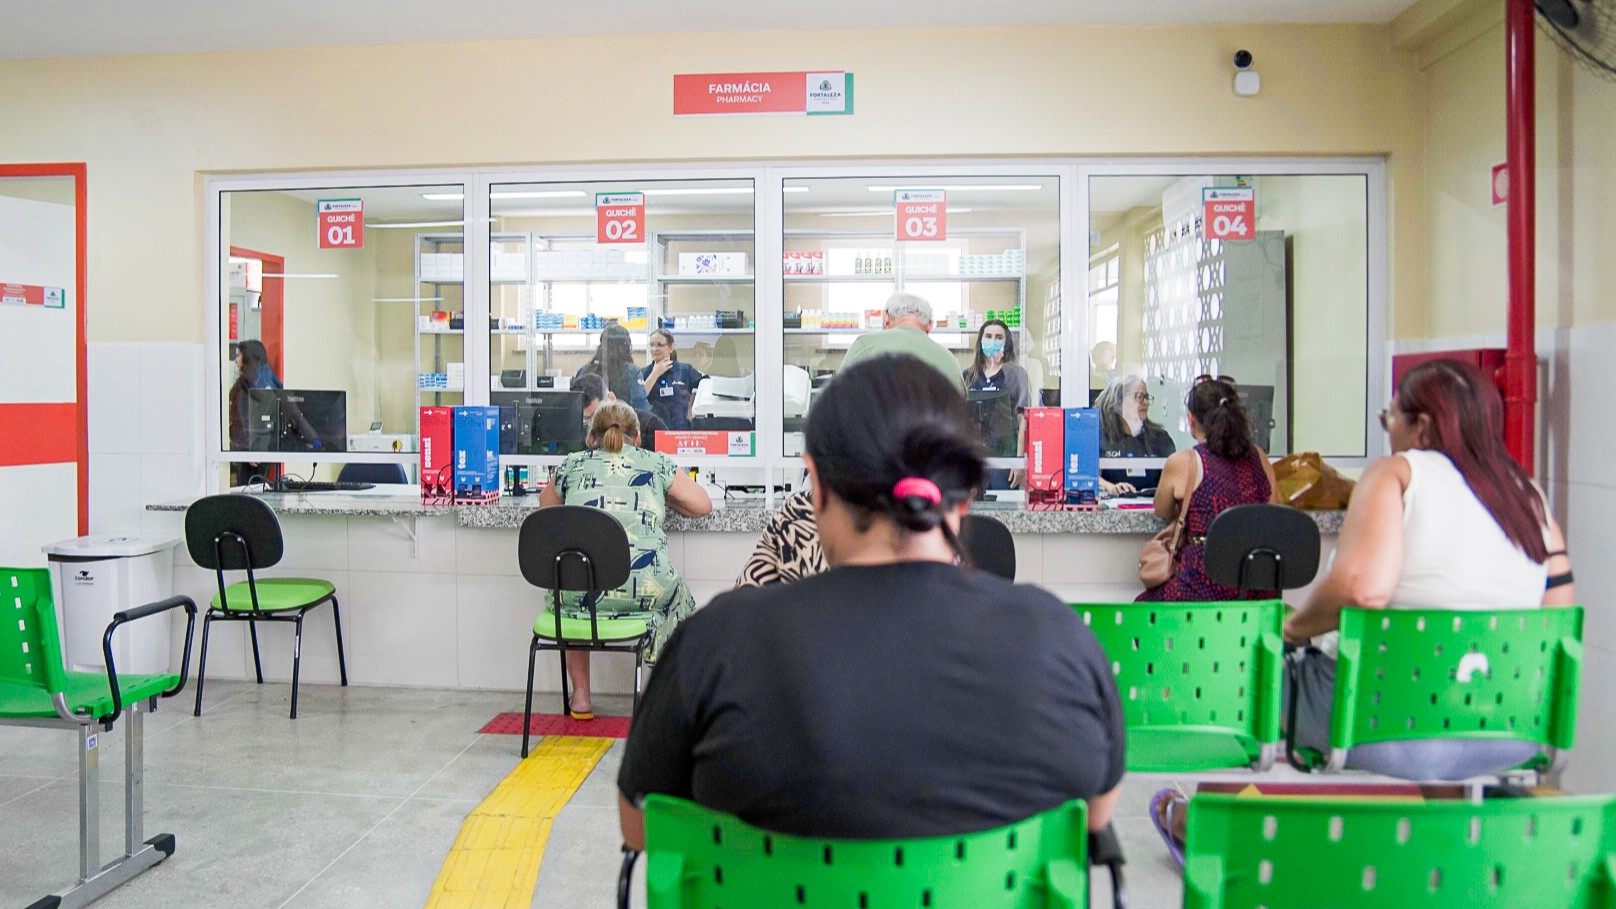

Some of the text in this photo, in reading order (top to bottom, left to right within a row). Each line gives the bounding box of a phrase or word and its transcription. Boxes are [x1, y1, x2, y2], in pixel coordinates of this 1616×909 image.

[708, 80, 772, 94] FARMÁCIA
[716, 95, 763, 104] PHARMACY
[605, 207, 637, 217] GUICHÊ
[905, 203, 938, 214] GUICHÊ
[1213, 202, 1246, 212] GUICHÊ
[327, 213, 356, 223] GUICHÊ
[1213, 215, 1247, 236] 04
[327, 225, 356, 245] 01
[605, 219, 638, 240] 02
[905, 217, 938, 238] 03
[457, 450, 466, 469] tex
[1068, 453, 1079, 474] tex
